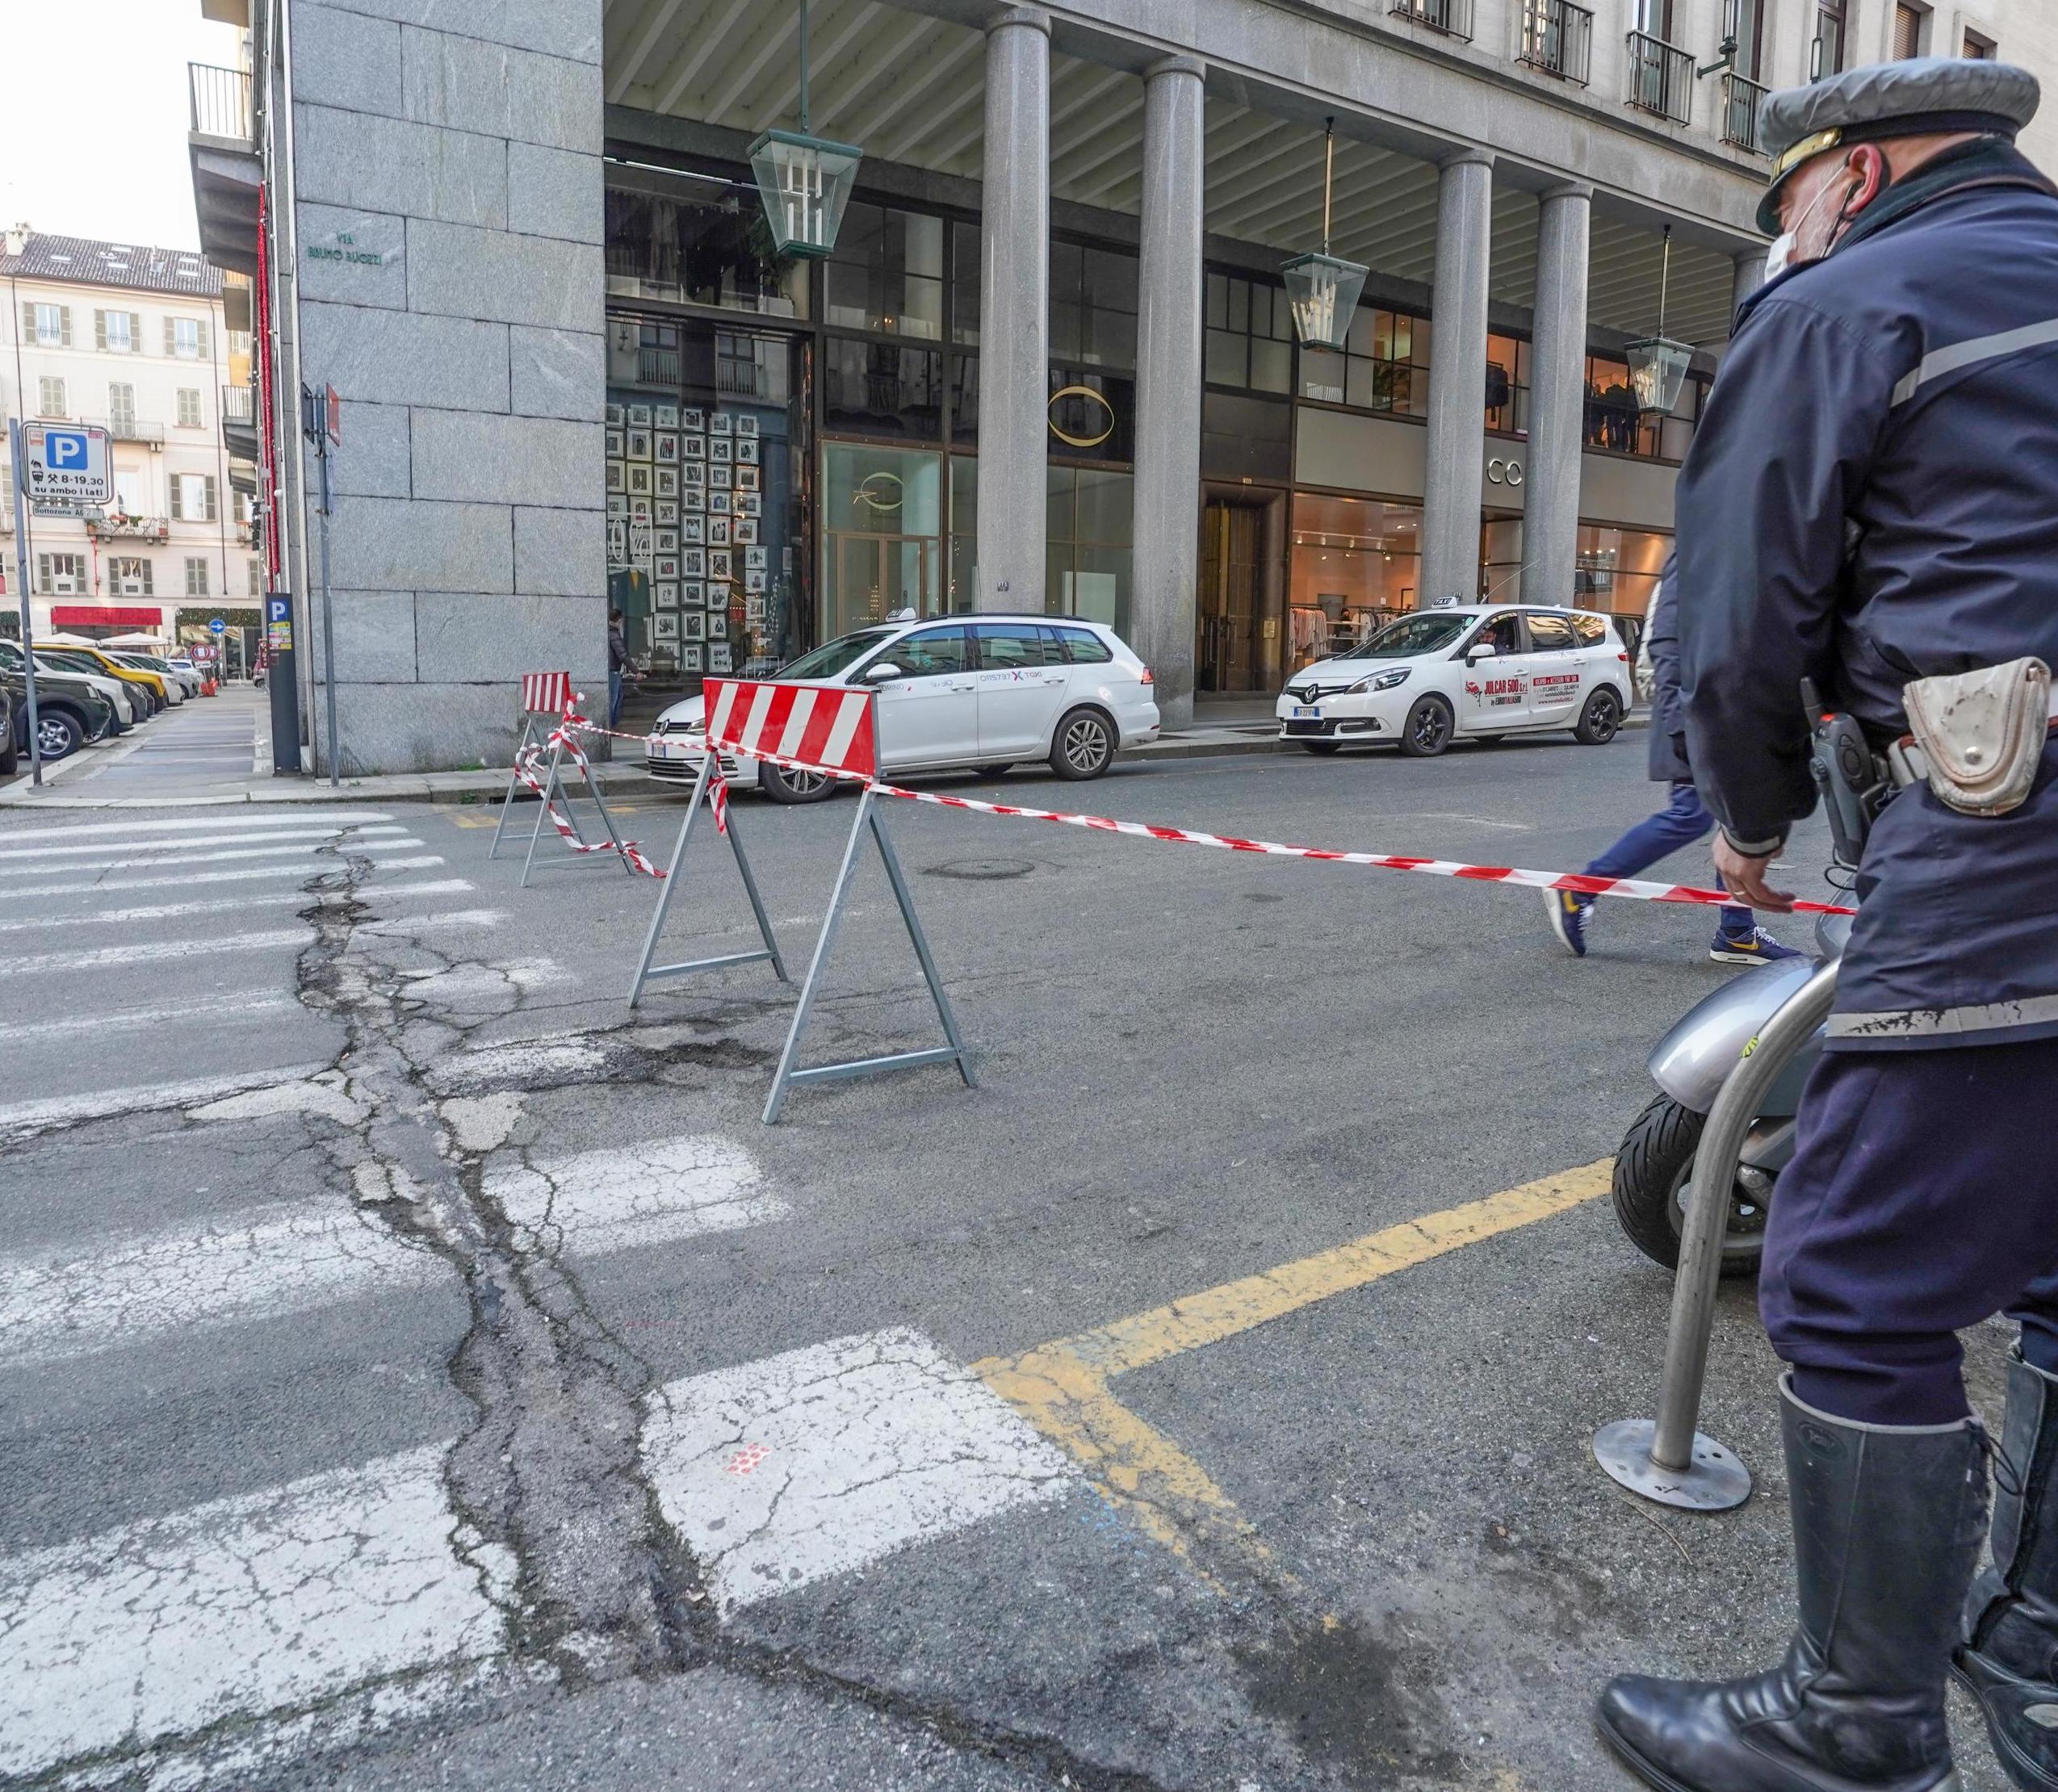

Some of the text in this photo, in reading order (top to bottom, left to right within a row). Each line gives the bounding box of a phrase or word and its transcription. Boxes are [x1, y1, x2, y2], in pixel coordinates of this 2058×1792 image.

[336, 232, 354, 245] VIA
[308, 245, 383, 266] BRUNO BUOZZI
[54, 437, 80, 466] P
[1486, 458, 1524, 487] CO
[86, 488, 103, 496] lati
[34, 507, 72, 516] Sottozona
[271, 601, 286, 621] P
[1485, 680, 1507, 695] JULCAR
[1507, 679, 1519, 693] 500
